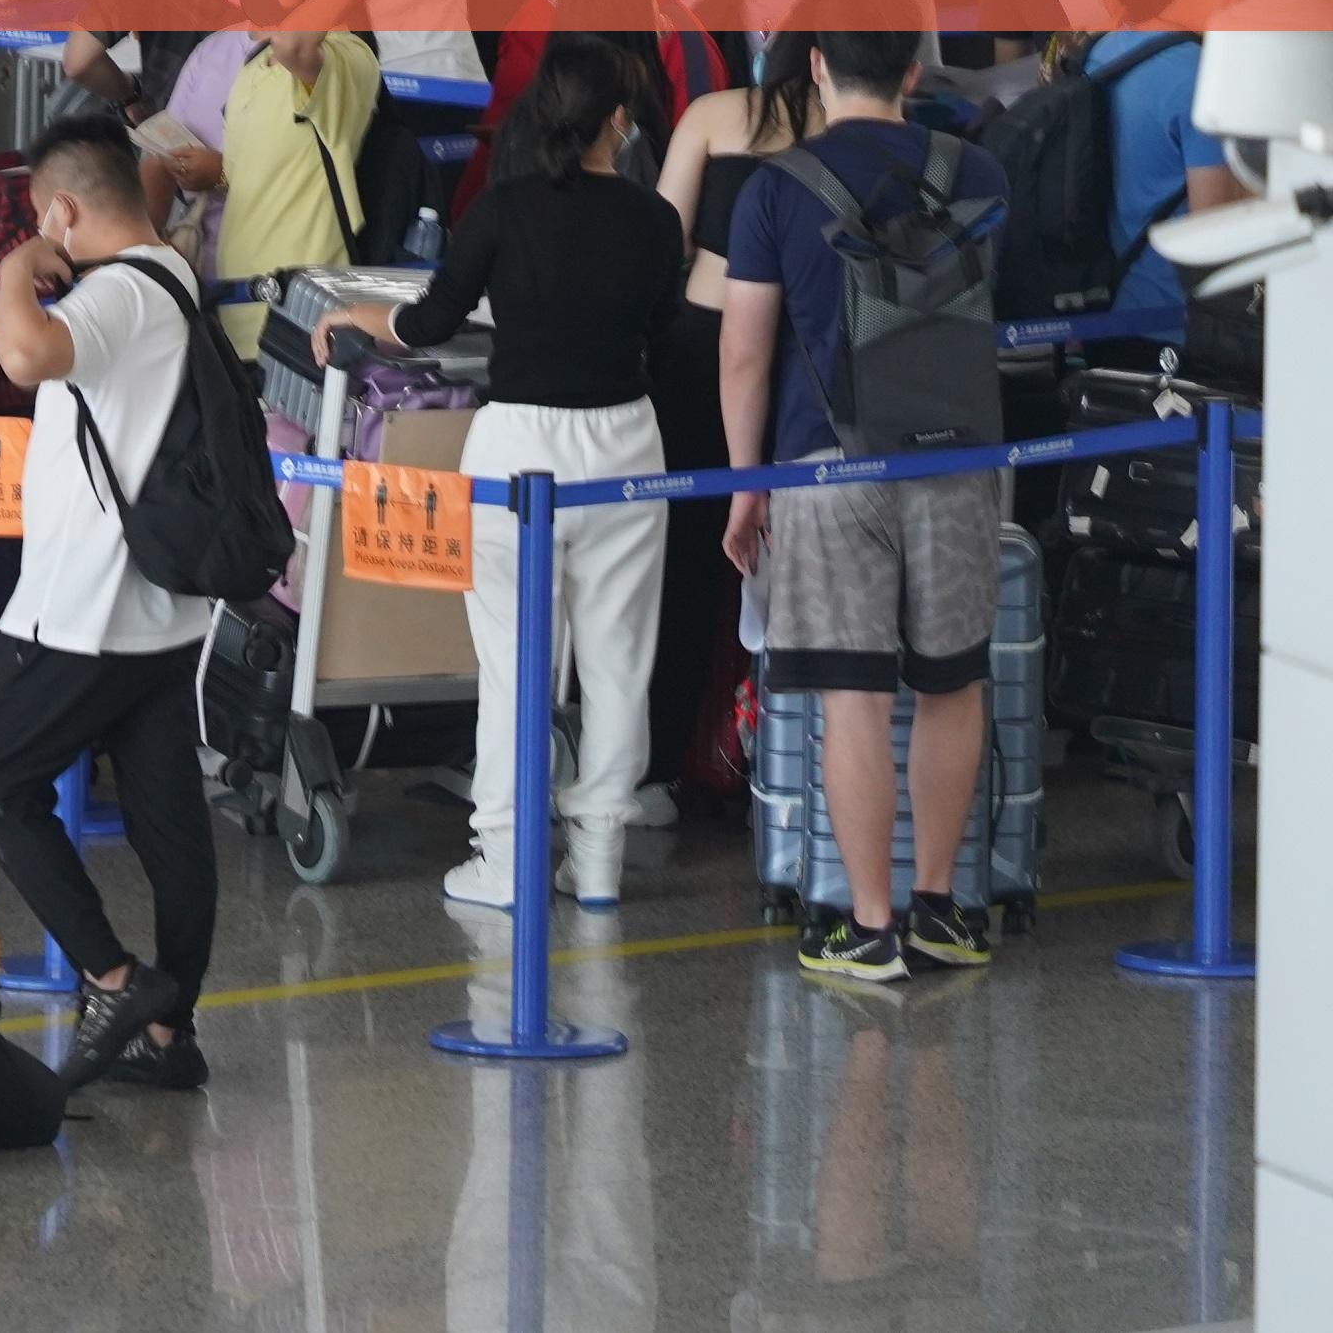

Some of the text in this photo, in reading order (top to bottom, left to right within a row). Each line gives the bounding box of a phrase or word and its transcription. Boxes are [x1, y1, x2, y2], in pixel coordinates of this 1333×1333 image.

[353, 525, 462, 559] 请保持距离
[354, 550, 465, 577] Please Keep Distance
